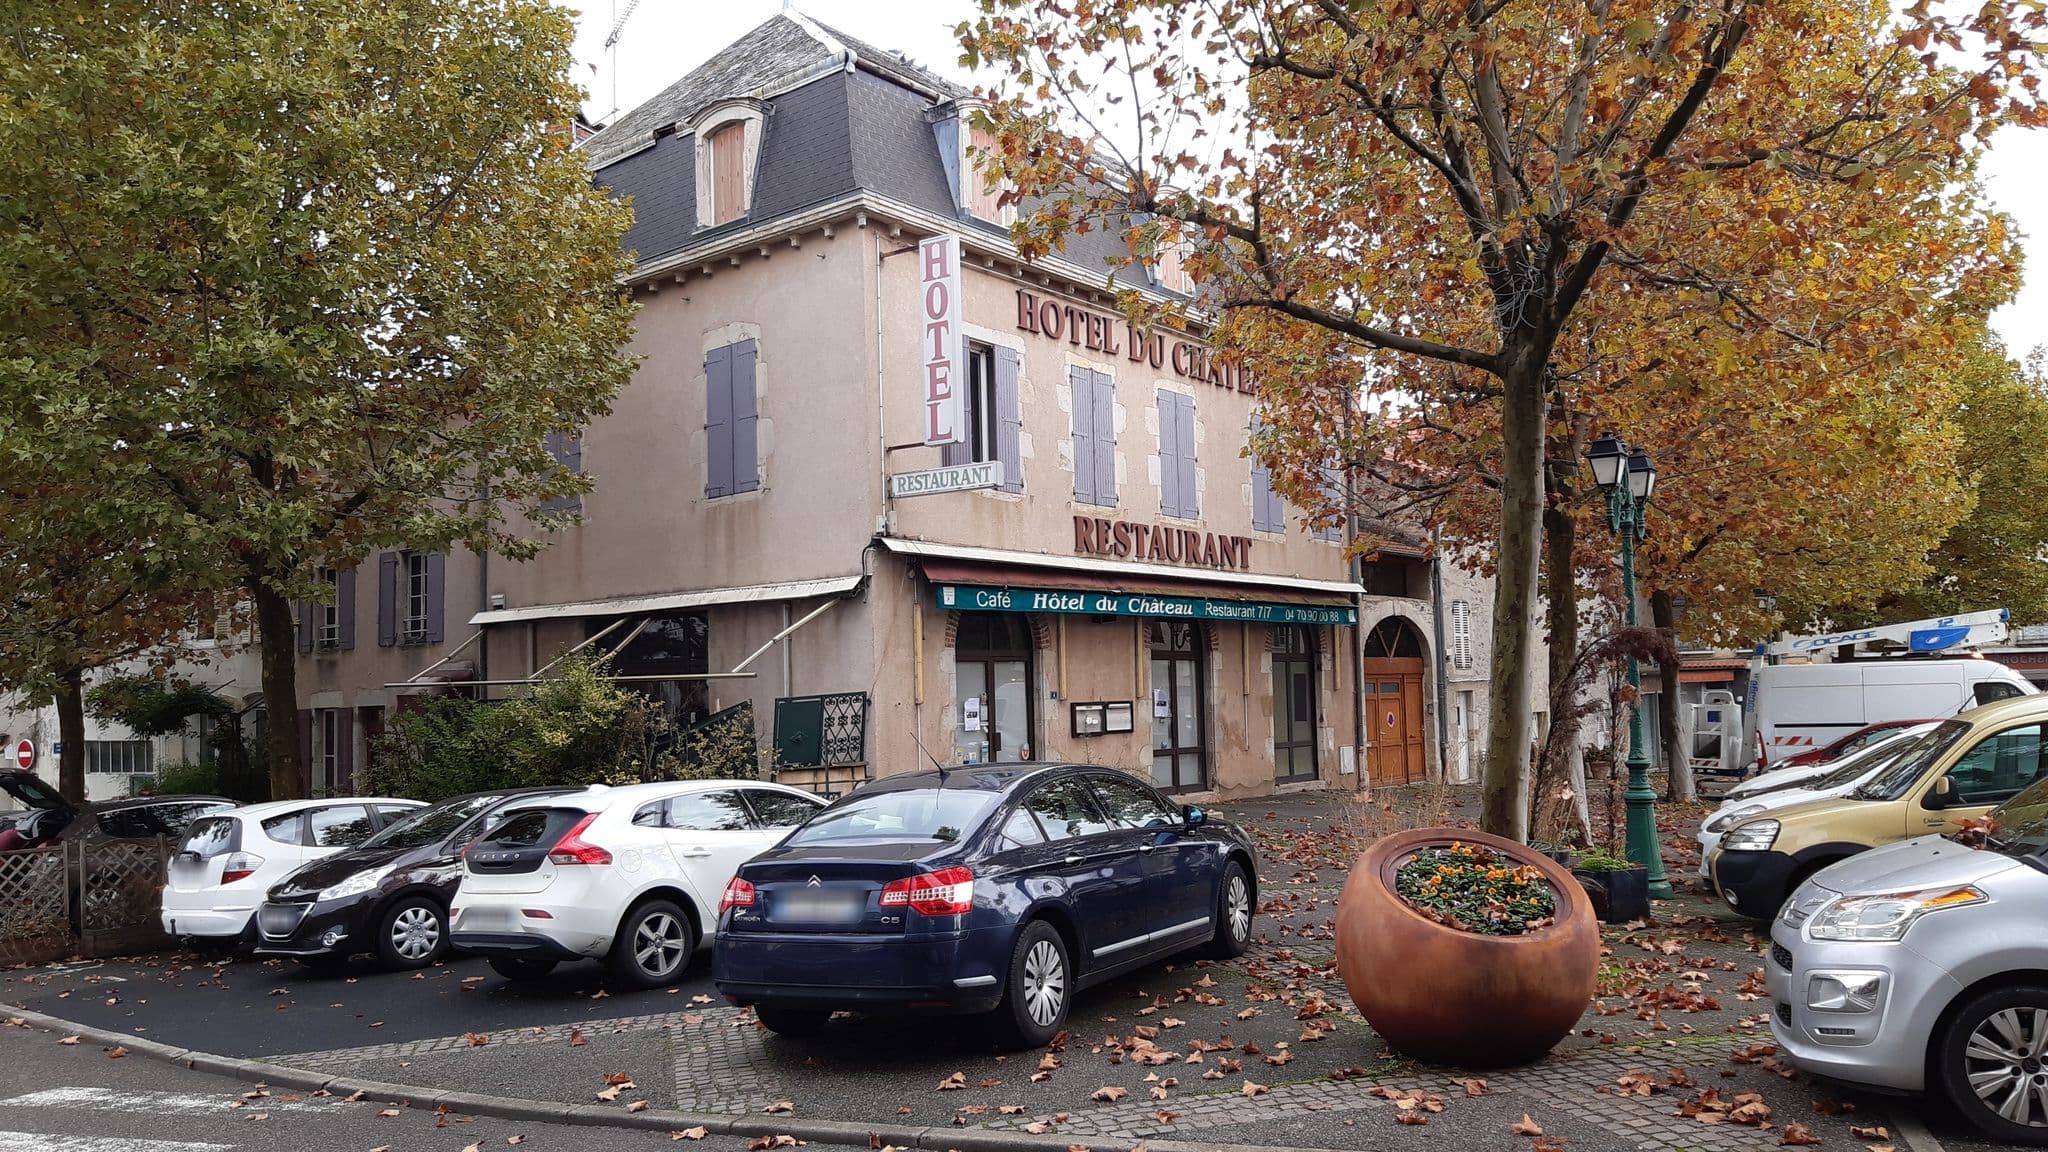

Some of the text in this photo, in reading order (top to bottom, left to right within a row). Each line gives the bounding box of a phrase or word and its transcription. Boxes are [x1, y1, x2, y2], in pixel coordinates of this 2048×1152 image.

[921, 238, 953, 442] HOTEL
[1016, 289, 1257, 396] HOTEL DU CHATE
[896, 466, 992, 493] RESTAURANT
[1073, 515, 1253, 569] RESTAURANT
[976, 590, 1012, 608] Café
[1032, 593, 1085, 610] Hôtel
[1095, 596, 1118, 612] du
[1128, 598, 1194, 615] Château
[1205, 602, 1255, 618] Restaurant
